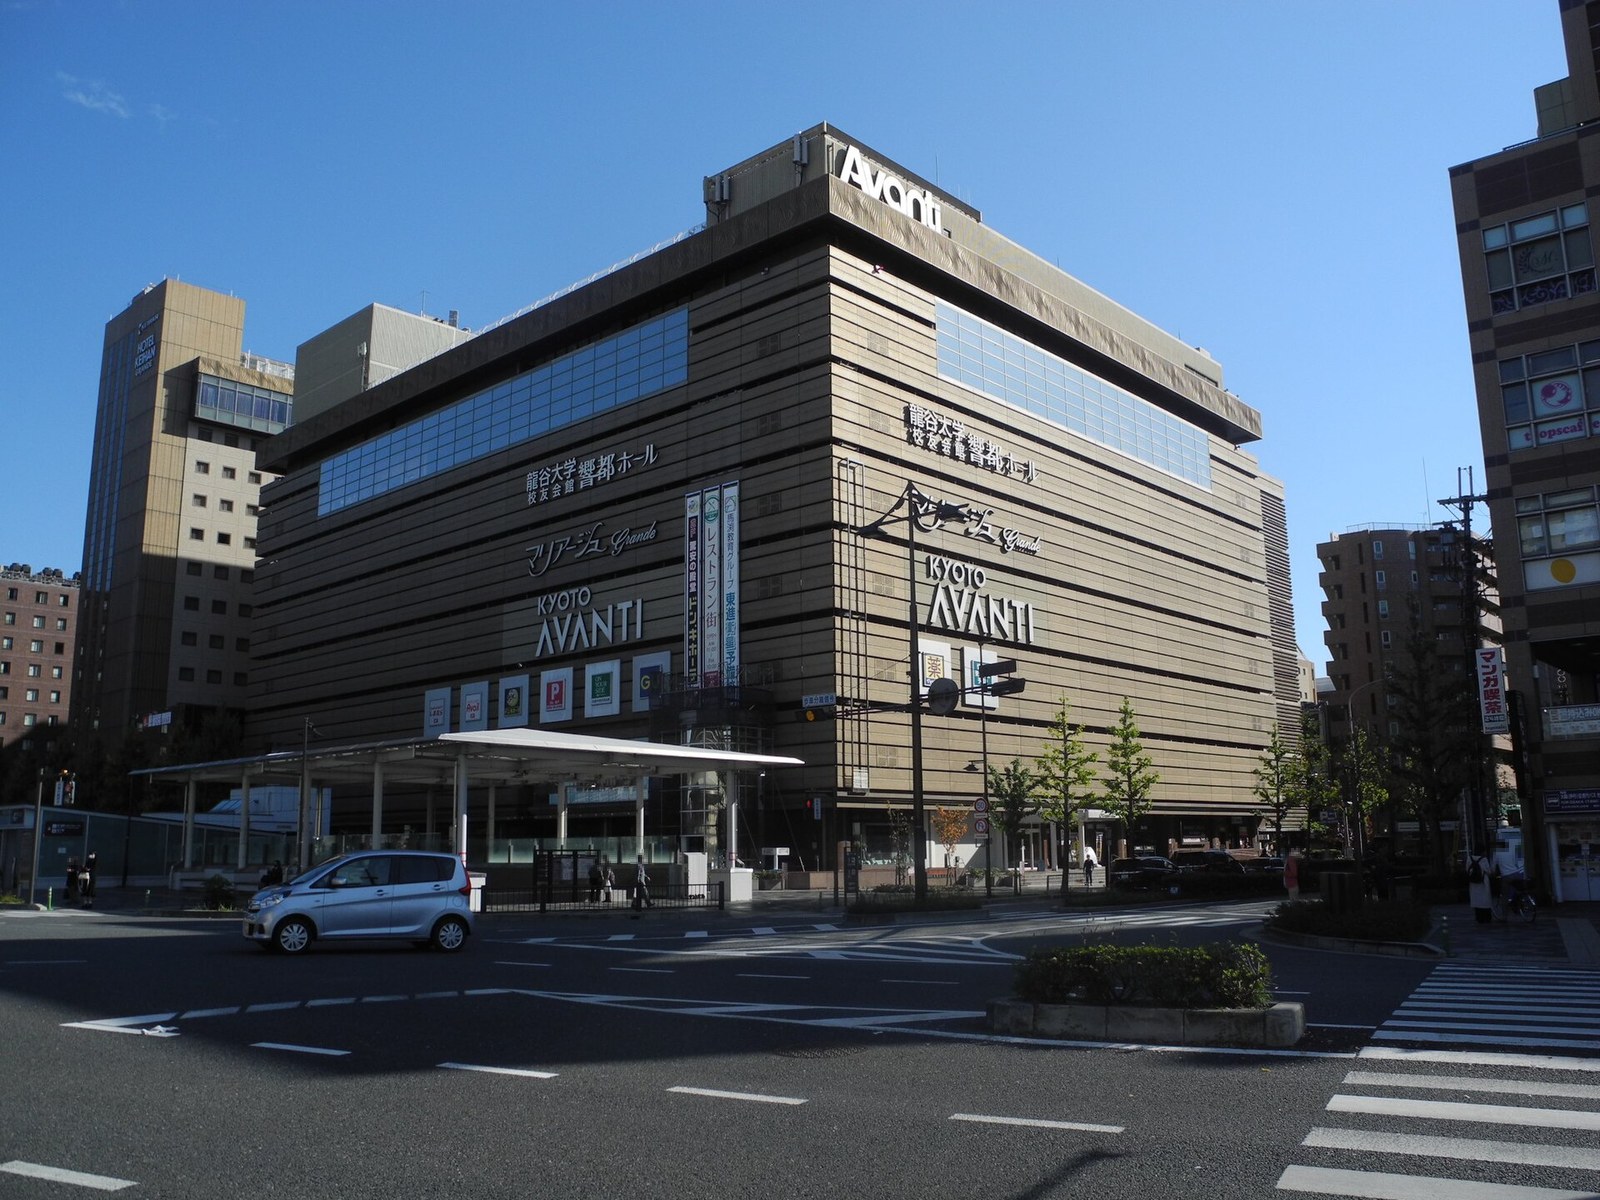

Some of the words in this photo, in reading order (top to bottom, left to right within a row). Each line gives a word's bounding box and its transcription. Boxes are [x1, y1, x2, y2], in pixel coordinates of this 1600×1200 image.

[839, 144, 942, 235] Avanti
[908, 403, 966, 442] 龍谷大学
[526, 457, 577, 493] 龍谷大学
[527, 478, 575, 505] 校友会館
[610, 520, 657, 557] Grande
[1002, 527, 1042, 554] Grande
[706, 527, 718, 629] レストラン街
[929, 555, 987, 588] KYOTO
[537, 586, 592, 616] KYOTO
[930, 582, 1035, 644] AVANTI
[535, 598, 643, 658] AVANTI
[927, 656, 942, 679] 薬
[1479, 651, 1502, 714] マンガ喫茶
